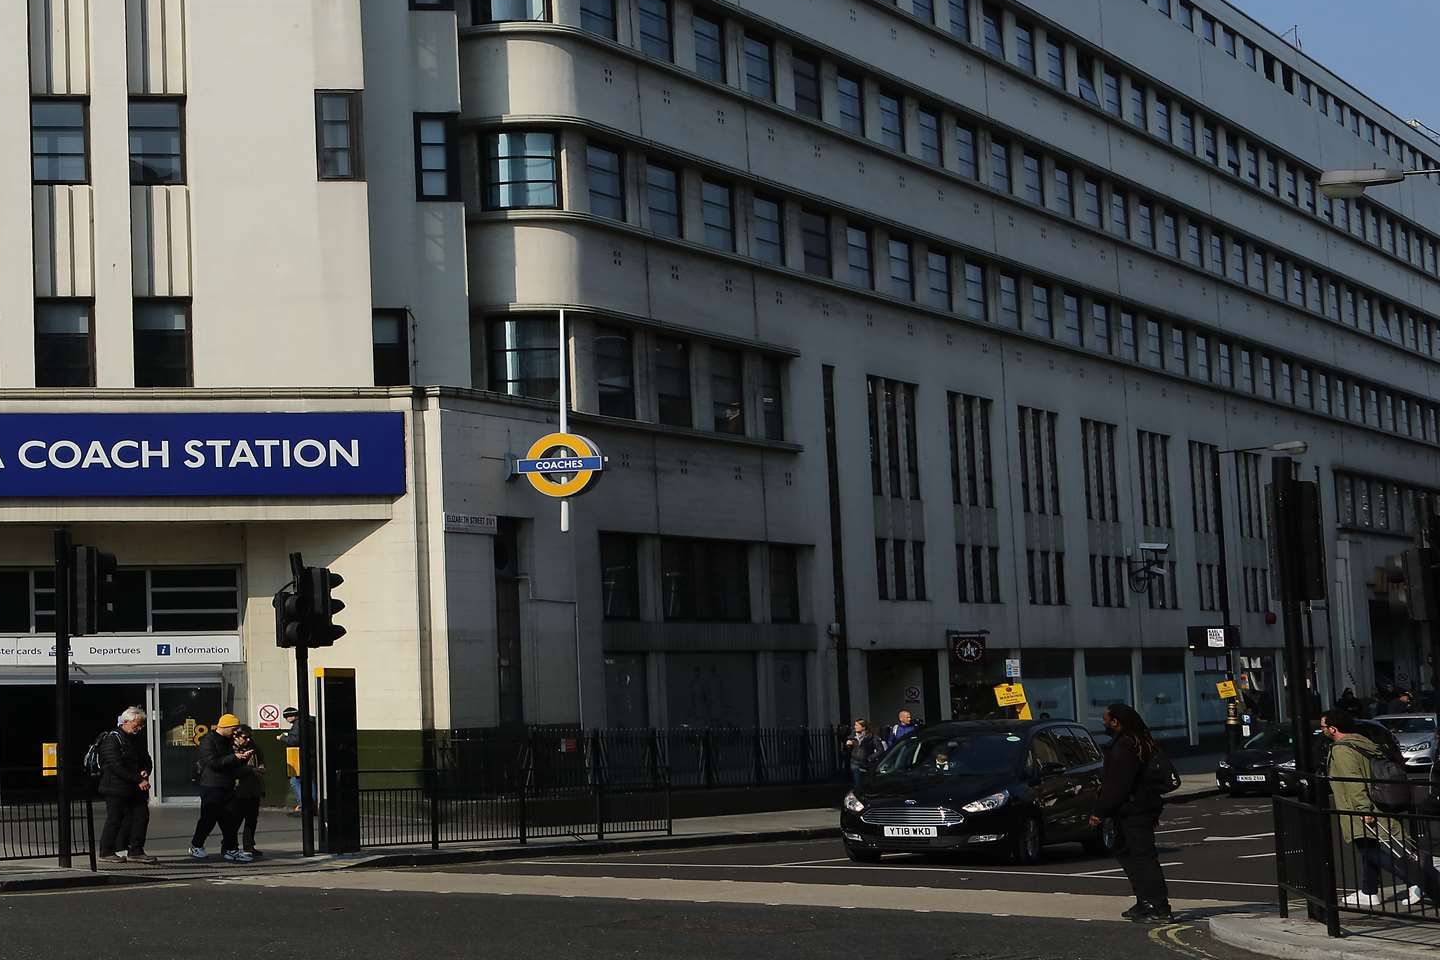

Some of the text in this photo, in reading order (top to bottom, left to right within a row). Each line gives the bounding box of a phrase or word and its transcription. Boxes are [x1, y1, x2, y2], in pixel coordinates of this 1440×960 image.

[17, 439, 170, 469] COACH
[182, 438, 359, 468] STATION
[535, 459, 583, 470] COACHES
[470, 516, 485, 525] STREET
[16, 647, 42, 656] cards
[89, 646, 141, 657] Departures
[175, 646, 229, 654] Information
[889, 827, 931, 836] YT18 WKD
